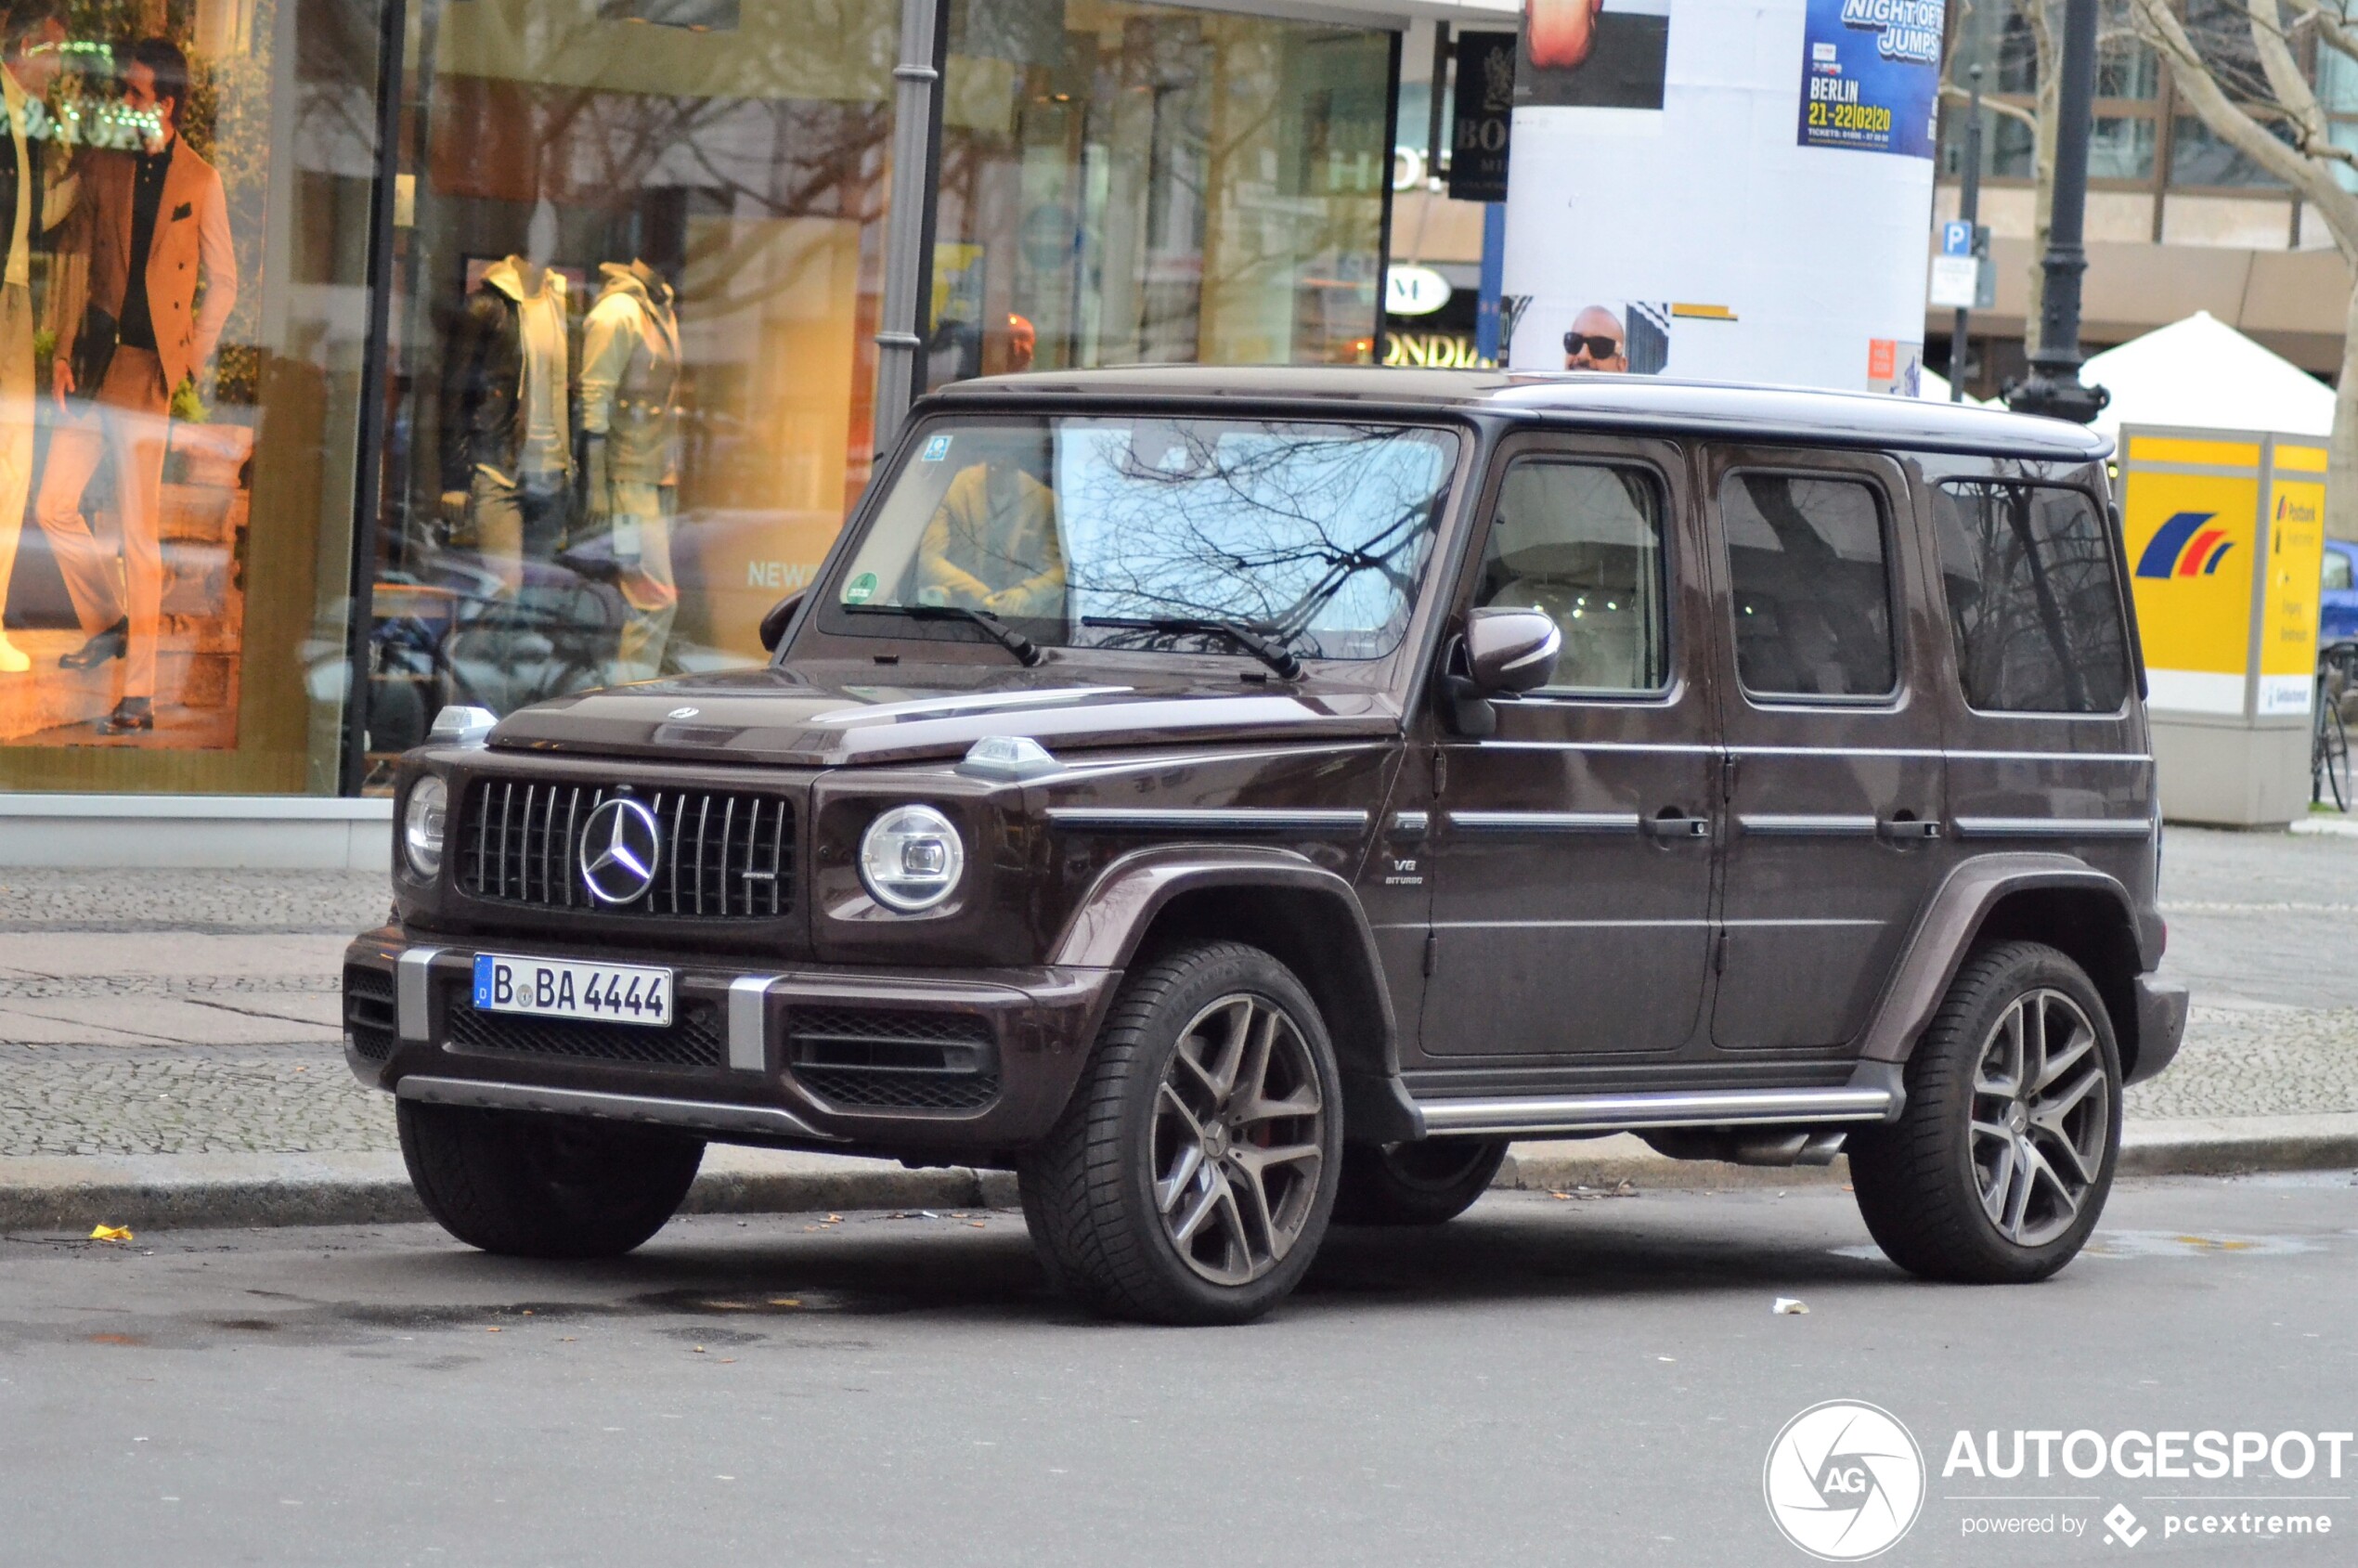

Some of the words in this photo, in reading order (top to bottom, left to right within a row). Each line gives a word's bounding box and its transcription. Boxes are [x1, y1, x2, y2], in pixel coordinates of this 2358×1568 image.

[1844, 0, 1916, 25] NIGHT
[1880, 27, 1939, 59] JUMPS
[1809, 76, 1859, 103] BERLIN
[1947, 225, 1965, 253] P
[1385, 876, 1423, 885] BITURBO
[479, 987, 487, 1000] D
[494, 964, 513, 1004] B
[536, 967, 577, 1010] BA
[584, 972, 664, 1017] 4444
